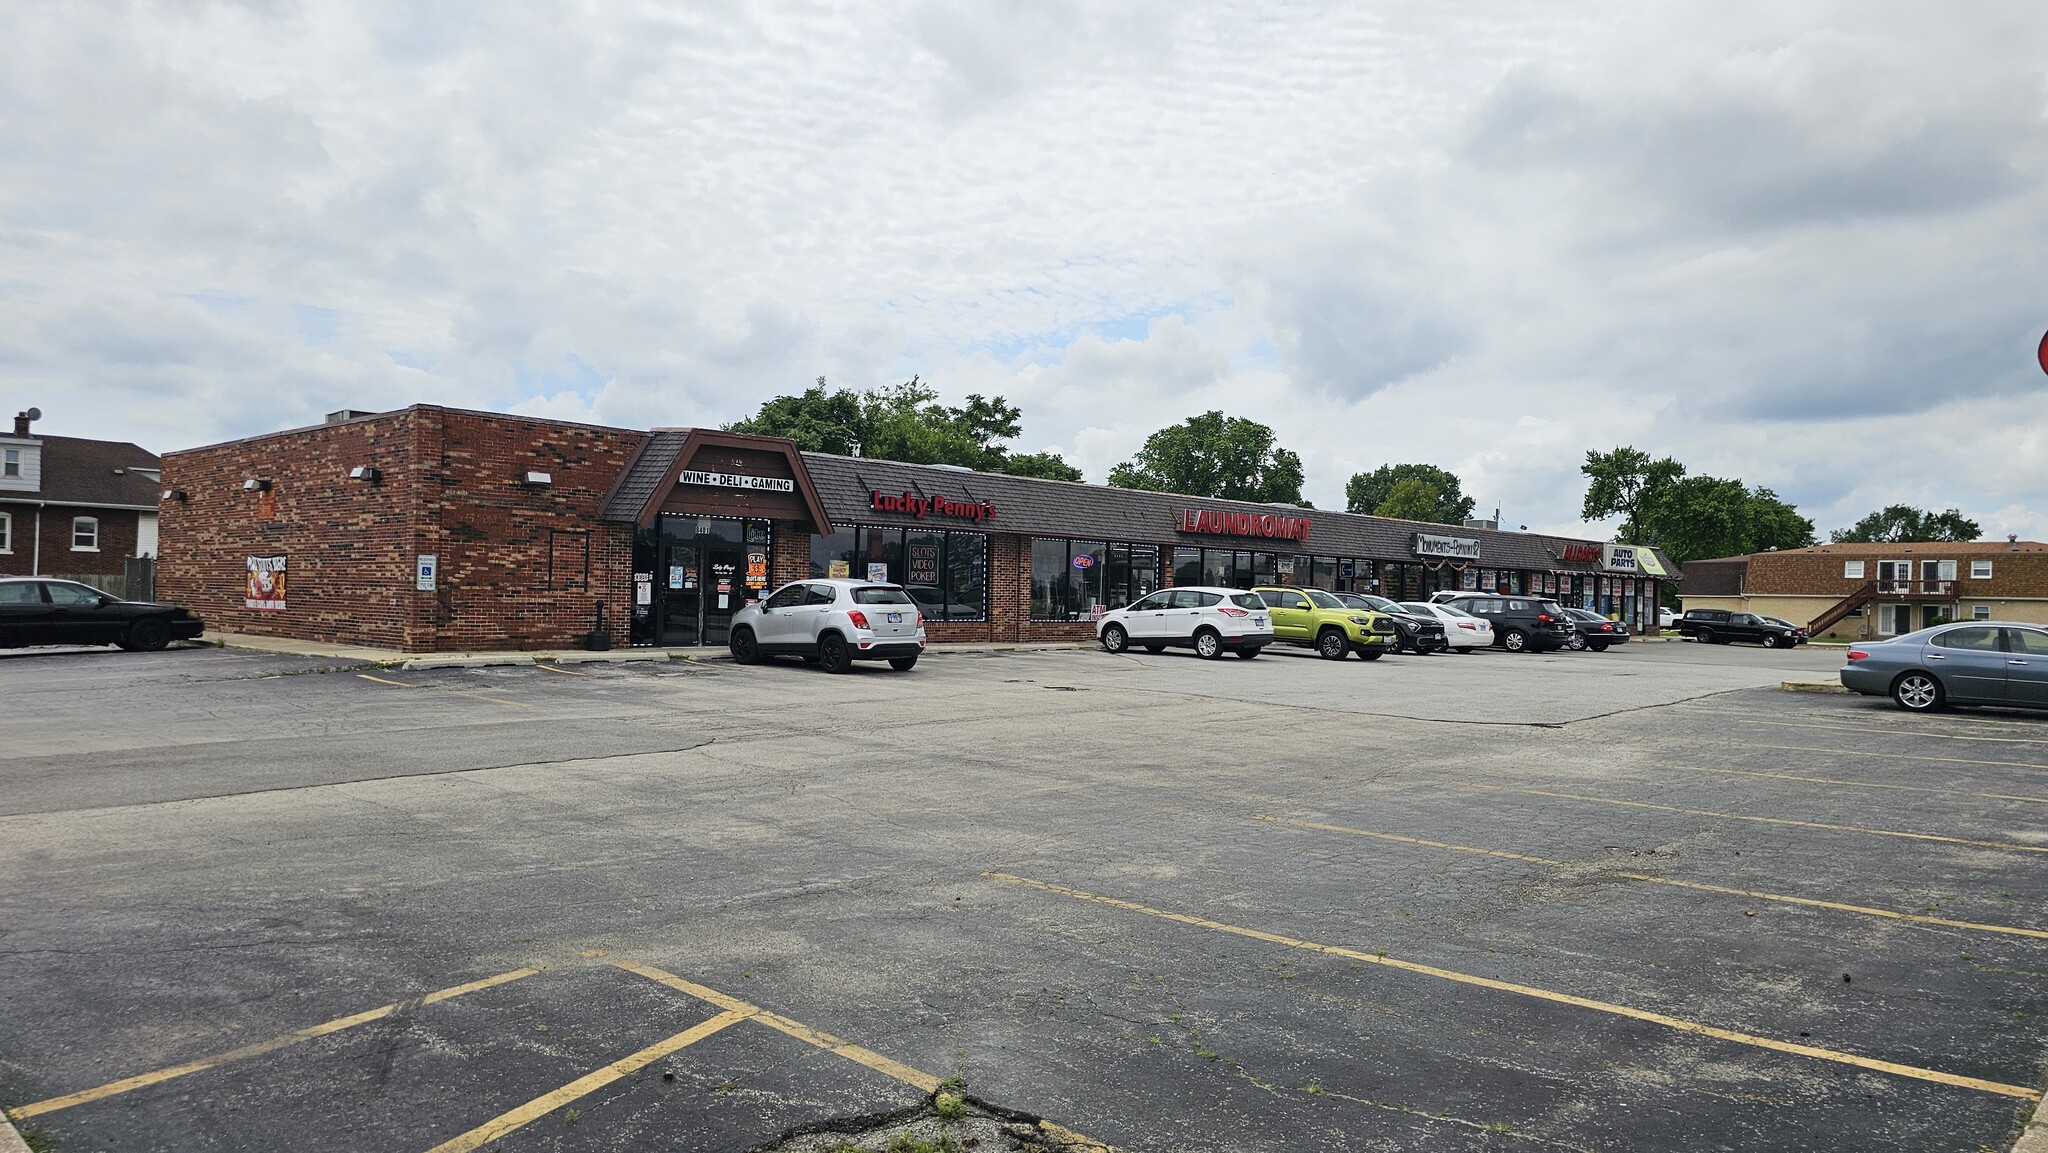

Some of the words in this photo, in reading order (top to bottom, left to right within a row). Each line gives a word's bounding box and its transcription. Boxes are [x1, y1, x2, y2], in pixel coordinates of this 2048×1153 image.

[683, 472, 710, 483] WINE
[720, 475, 742, 486] DELI
[751, 478, 790, 490] GAMING
[873, 489, 928, 519] Lucky
[933, 495, 997, 522] Penny's
[1184, 509, 1312, 540] LAUNDROMAT
[912, 546, 935, 558] SLOTS
[1613, 549, 1633, 559] AUTO
[912, 560, 934, 570] VIDEO
[1075, 555, 1092, 567] OPEN
[1610, 558, 1635, 568] PARTS
[910, 571, 936, 581] POKER
[1092, 606, 1106, 614] ATM
